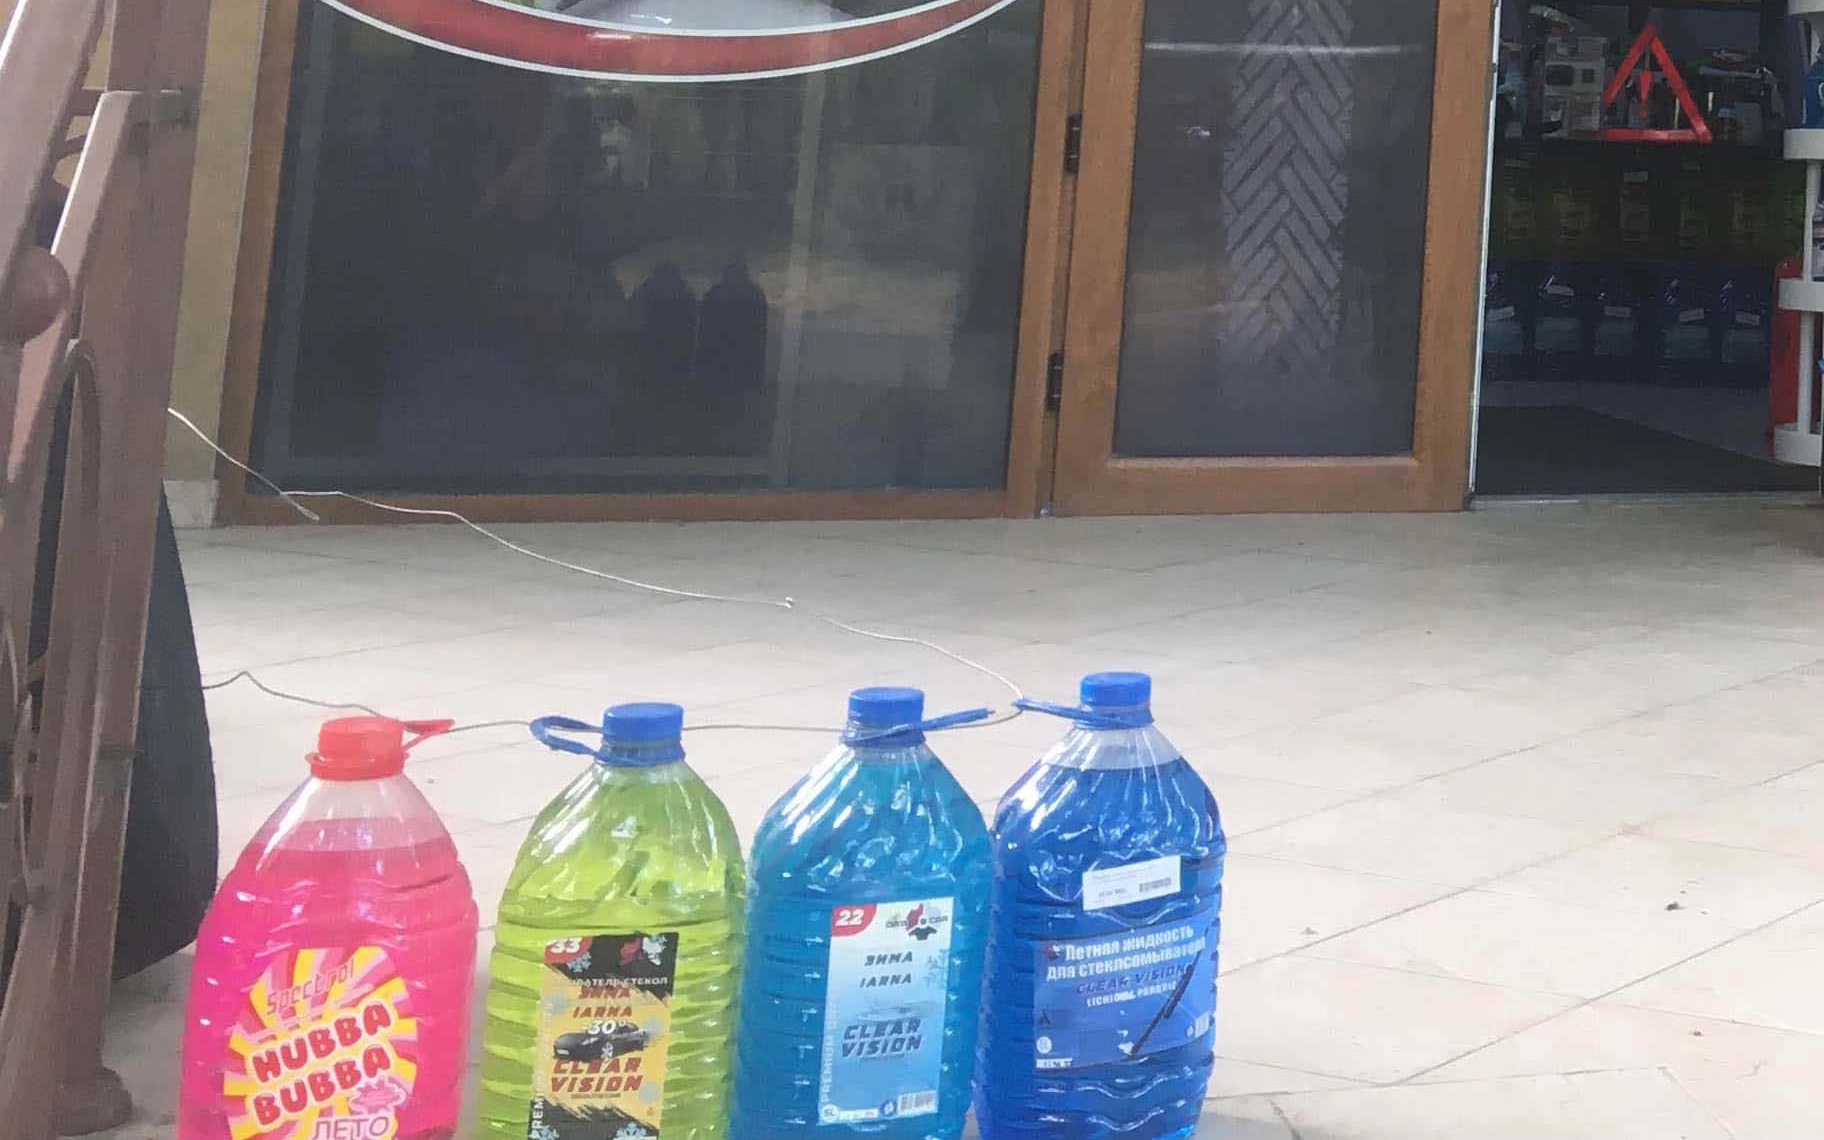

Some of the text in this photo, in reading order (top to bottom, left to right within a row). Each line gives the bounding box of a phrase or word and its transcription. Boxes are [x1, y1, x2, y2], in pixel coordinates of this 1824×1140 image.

[835, 909, 864, 926] 22
[550, 937, 581, 954] 33
[1122, 925, 1194, 951] жидкость
[864, 951, 913, 966] ЗИМА
[860, 973, 912, 988] IARNA
[1046, 966, 1076, 981] для
[1077, 964, 1188, 994] CLEAR VISION
[578, 986, 631, 1000] ЗИМА
[573, 1006, 632, 1018] IARNA
[844, 1018, 921, 1041] CLEAR
[252, 1003, 391, 1084] HUBBA
[842, 1035, 923, 1057] VISION
[554, 1057, 641, 1074] CLEAR
[253, 1046, 391, 1126] BUBBA
[550, 1075, 643, 1093] VISION
[312, 1116, 389, 1140] ЛЕТО
